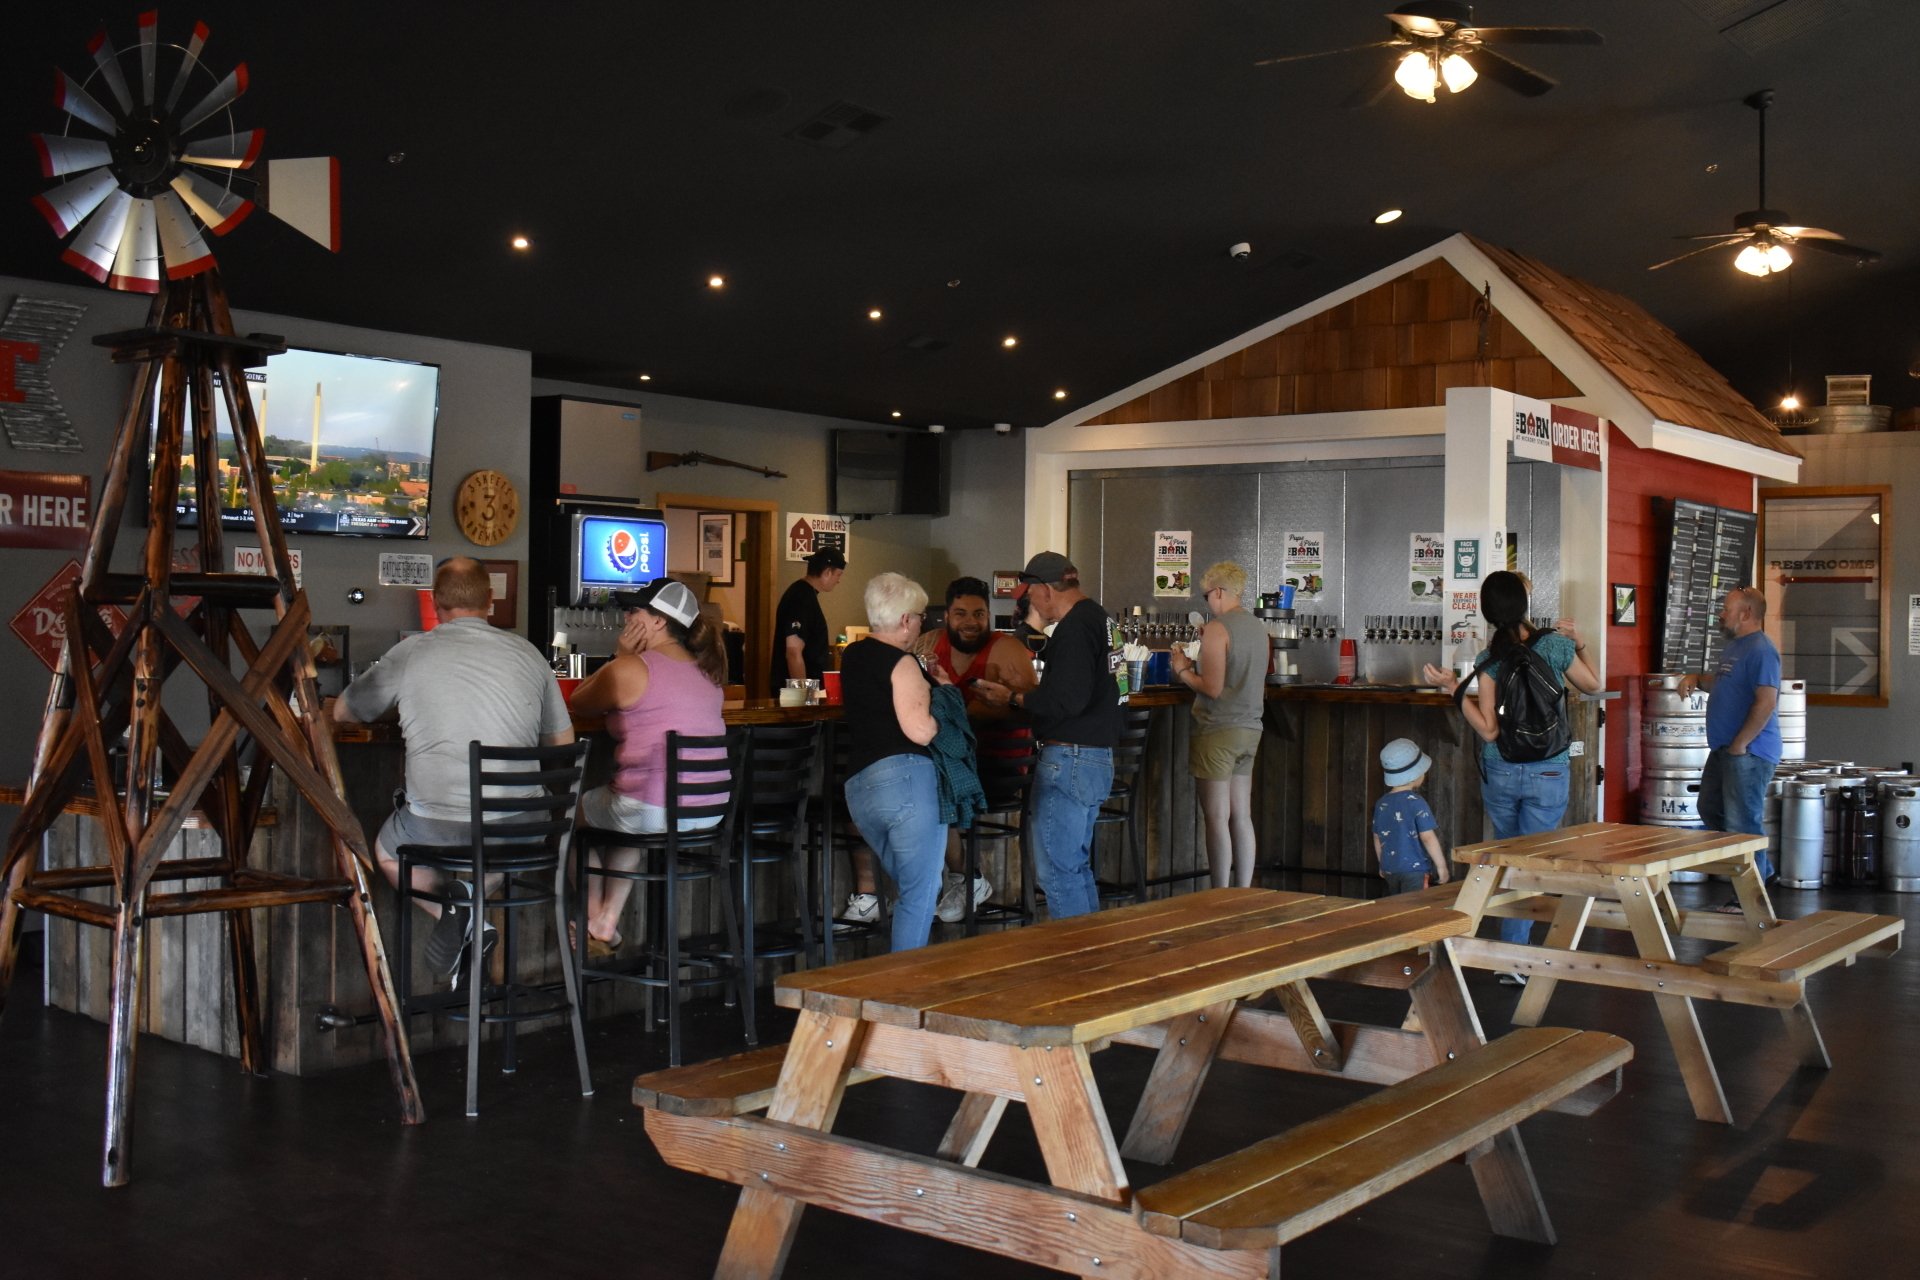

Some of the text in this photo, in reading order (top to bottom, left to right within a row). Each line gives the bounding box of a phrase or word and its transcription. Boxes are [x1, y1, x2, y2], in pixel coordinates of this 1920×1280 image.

[1520, 412, 1549, 439] BARN
[1552, 422, 1600, 455] ORDER HERE
[0, 493, 86, 528] R HERE
[481, 494, 496, 521] 3
[812, 519, 846, 531] GROWLERS
[639, 532, 650, 573] pepsi
[1161, 545, 1187, 554] BARN
[1292, 546, 1319, 556] BARN
[237, 552, 254, 567] NO
[1770, 560, 1875, 570] RESTROOMS
[1662, 800, 1675, 813] M
